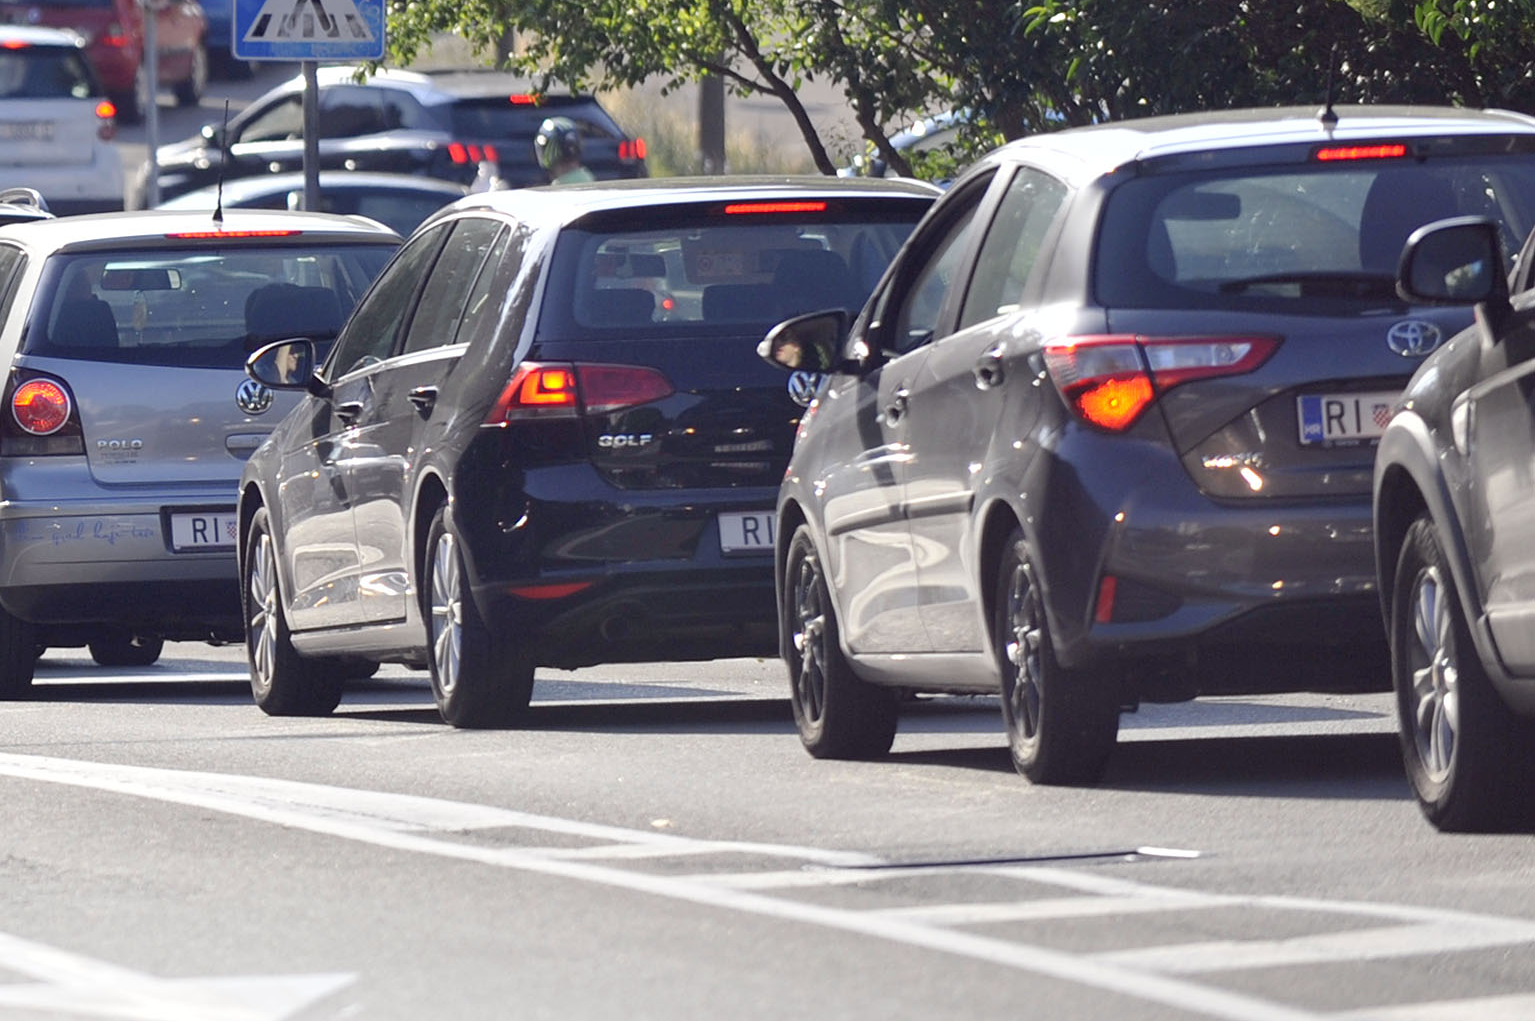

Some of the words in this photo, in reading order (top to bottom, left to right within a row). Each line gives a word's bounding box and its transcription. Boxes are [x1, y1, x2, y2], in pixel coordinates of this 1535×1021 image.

[1325, 399, 1362, 434] RI
[97, 439, 143, 450] POLO
[598, 434, 652, 448] GOLF
[192, 517, 220, 544] RI
[742, 515, 774, 546] RI
